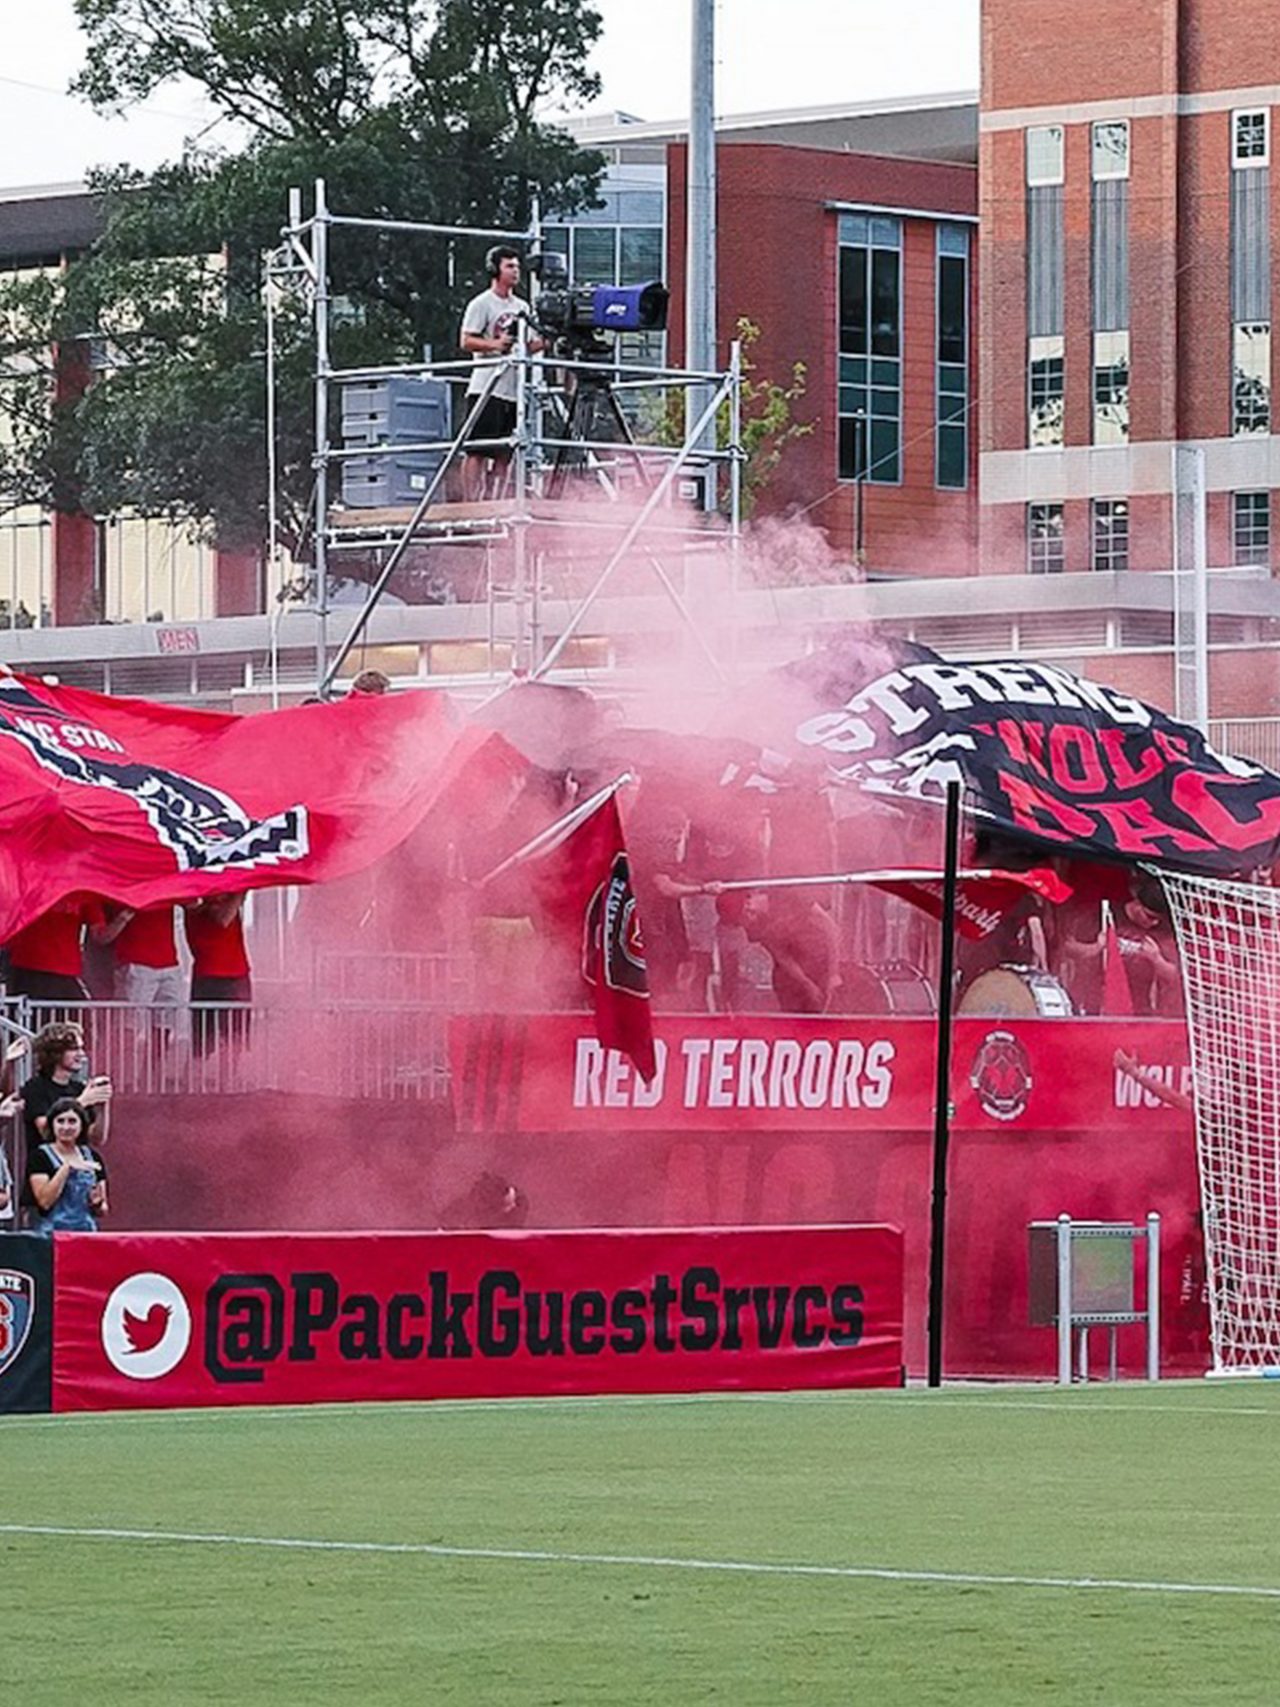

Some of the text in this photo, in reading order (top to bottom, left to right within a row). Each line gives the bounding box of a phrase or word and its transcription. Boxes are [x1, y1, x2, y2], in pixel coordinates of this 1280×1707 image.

[160, 630, 198, 651] MEN
[796, 661, 1153, 753] STRENG
[572, 1038, 895, 1109] RED TERRORS
[205, 1266, 866, 1384] @PackGuestSrvcs
